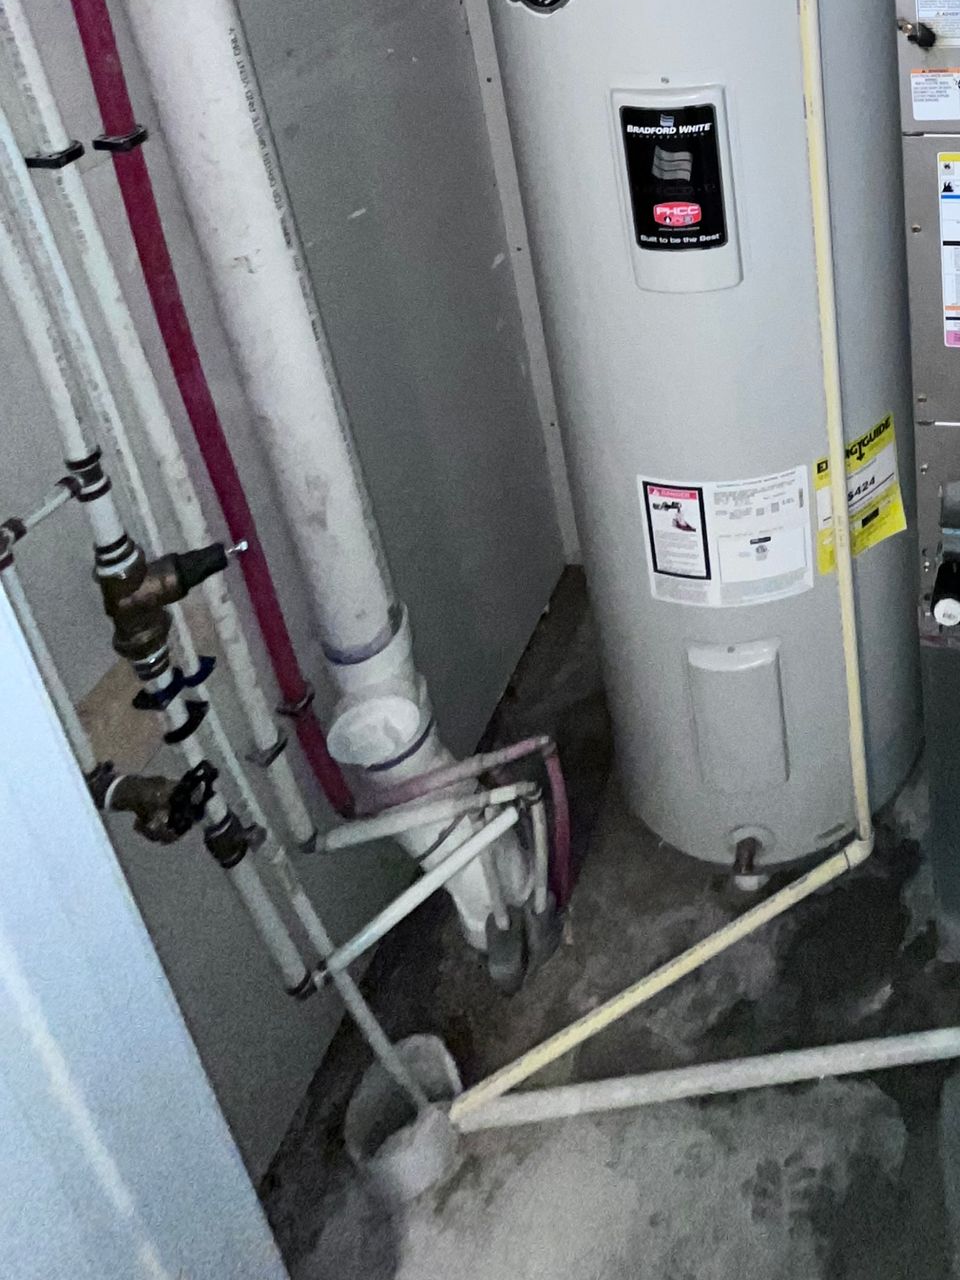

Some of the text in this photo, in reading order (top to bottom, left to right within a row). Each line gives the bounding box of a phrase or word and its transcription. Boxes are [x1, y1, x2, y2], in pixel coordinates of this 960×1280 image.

[626, 122, 711, 135] BRADFORD WHITE
[656, 206, 699, 216] PHCC
[640, 233, 719, 244] Built to be the Best
